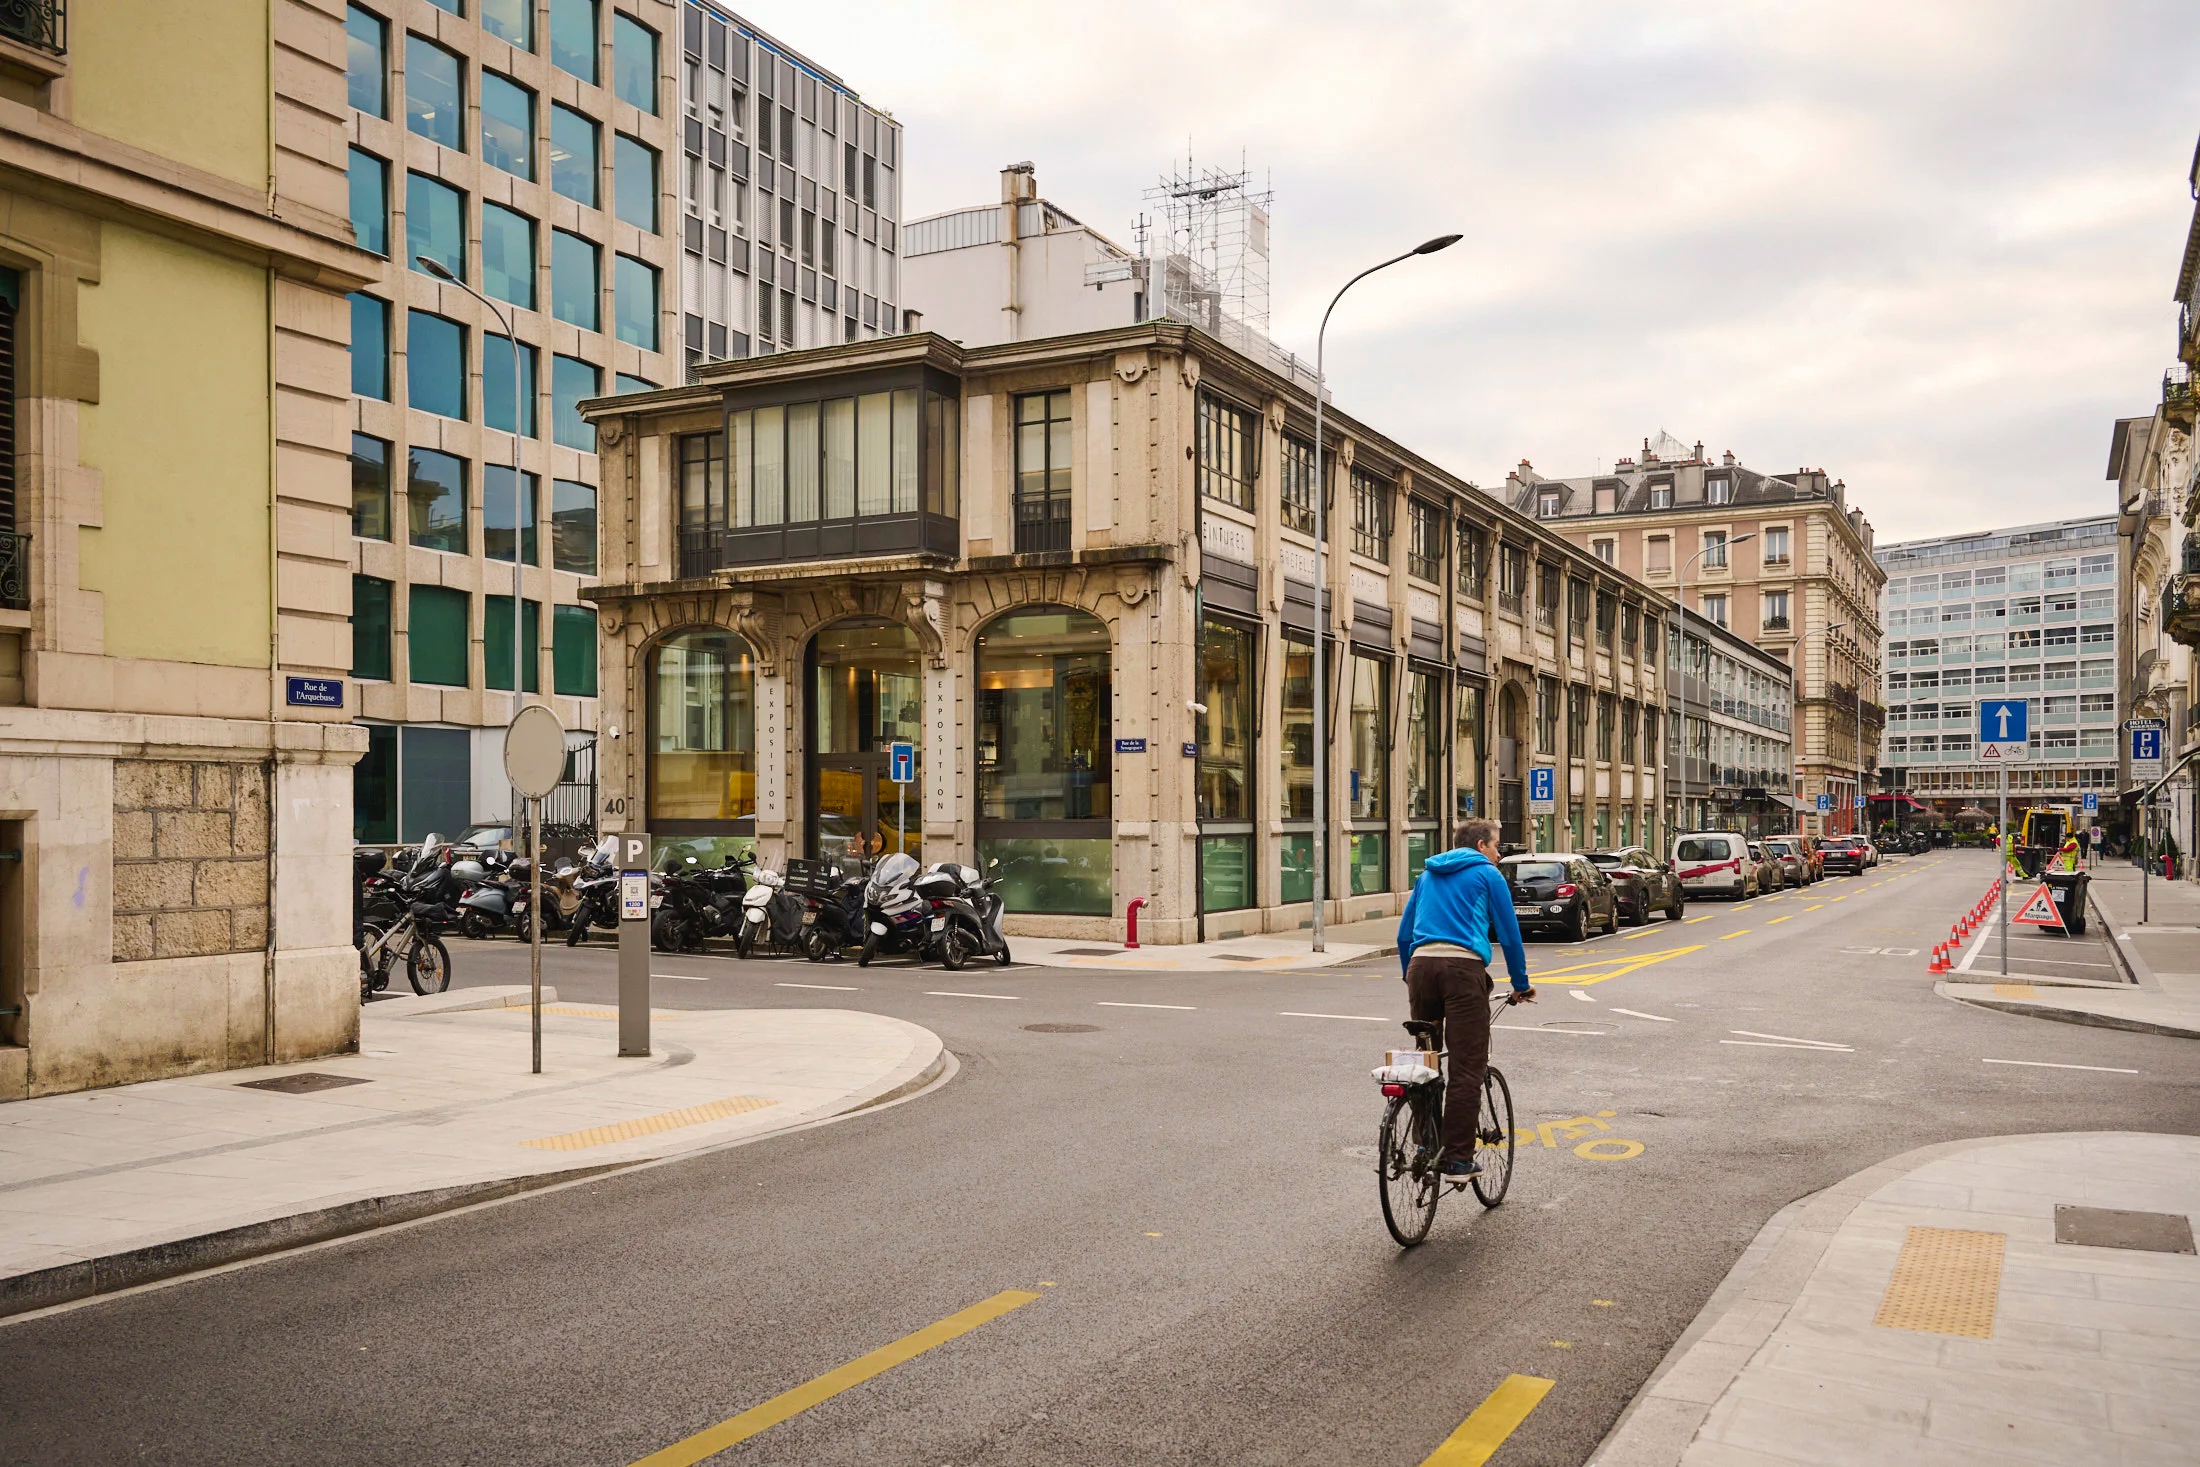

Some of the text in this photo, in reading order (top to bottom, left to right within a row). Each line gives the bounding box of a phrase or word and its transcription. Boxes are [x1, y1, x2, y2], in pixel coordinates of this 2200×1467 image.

[304, 682, 328, 692] Rue de
[296, 691, 336, 702] l'Arquebuse
[2141, 732, 2152, 747] P
[1537, 771, 1548, 787] P
[1820, 796, 1827, 804] P
[2087, 794, 2094, 803] P
[604, 798, 625, 814] 40
[627, 839, 644, 863] P
[2024, 912, 2054, 920] Marquage
[1839, 946, 1920, 956] 30
